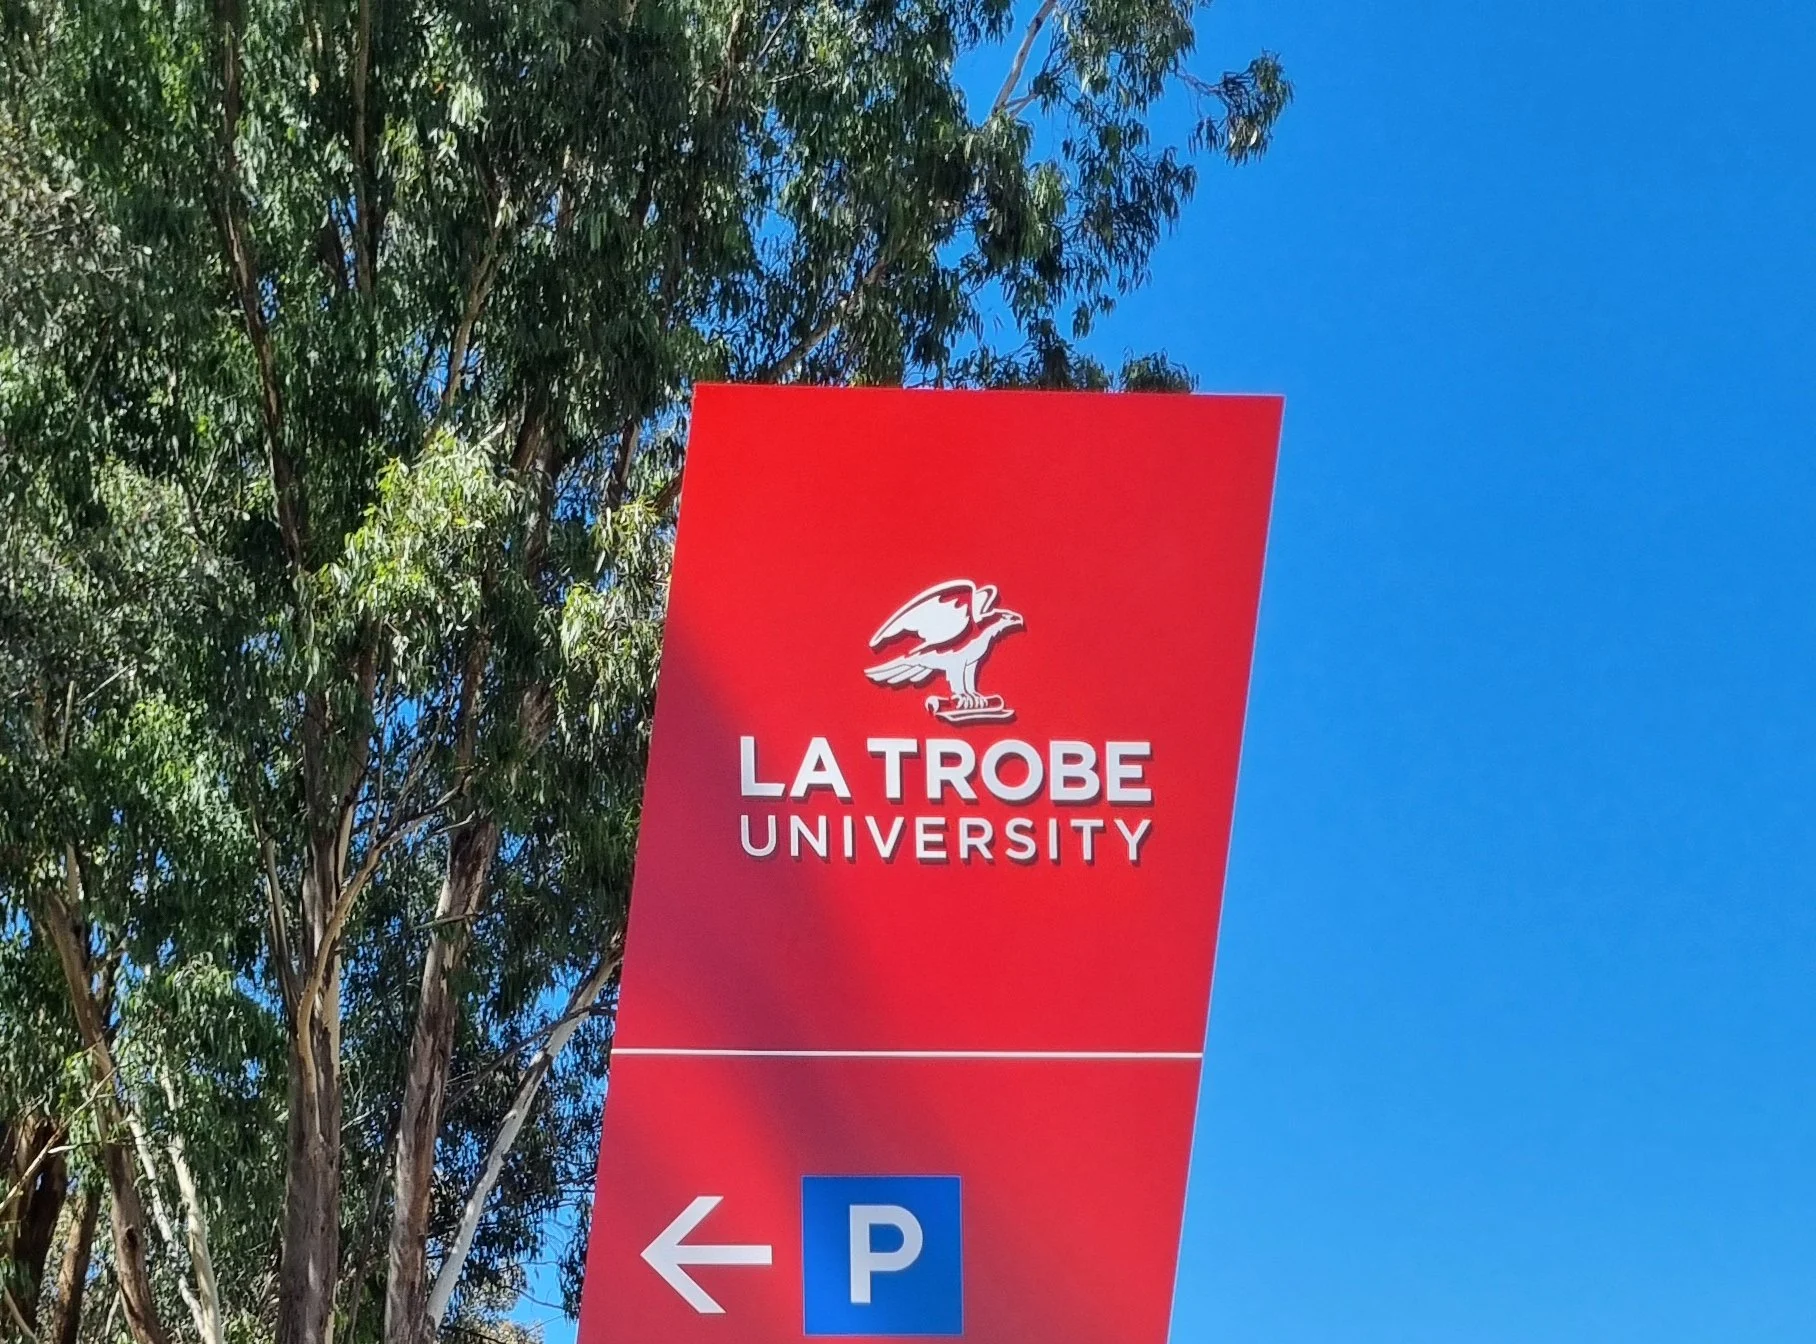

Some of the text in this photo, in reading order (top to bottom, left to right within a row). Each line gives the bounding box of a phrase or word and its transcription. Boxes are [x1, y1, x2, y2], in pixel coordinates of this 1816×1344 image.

[740, 735, 1153, 802] LA TROBE
[740, 814, 1153, 861] UNIVERSITY
[849, 1204, 924, 1304] P
